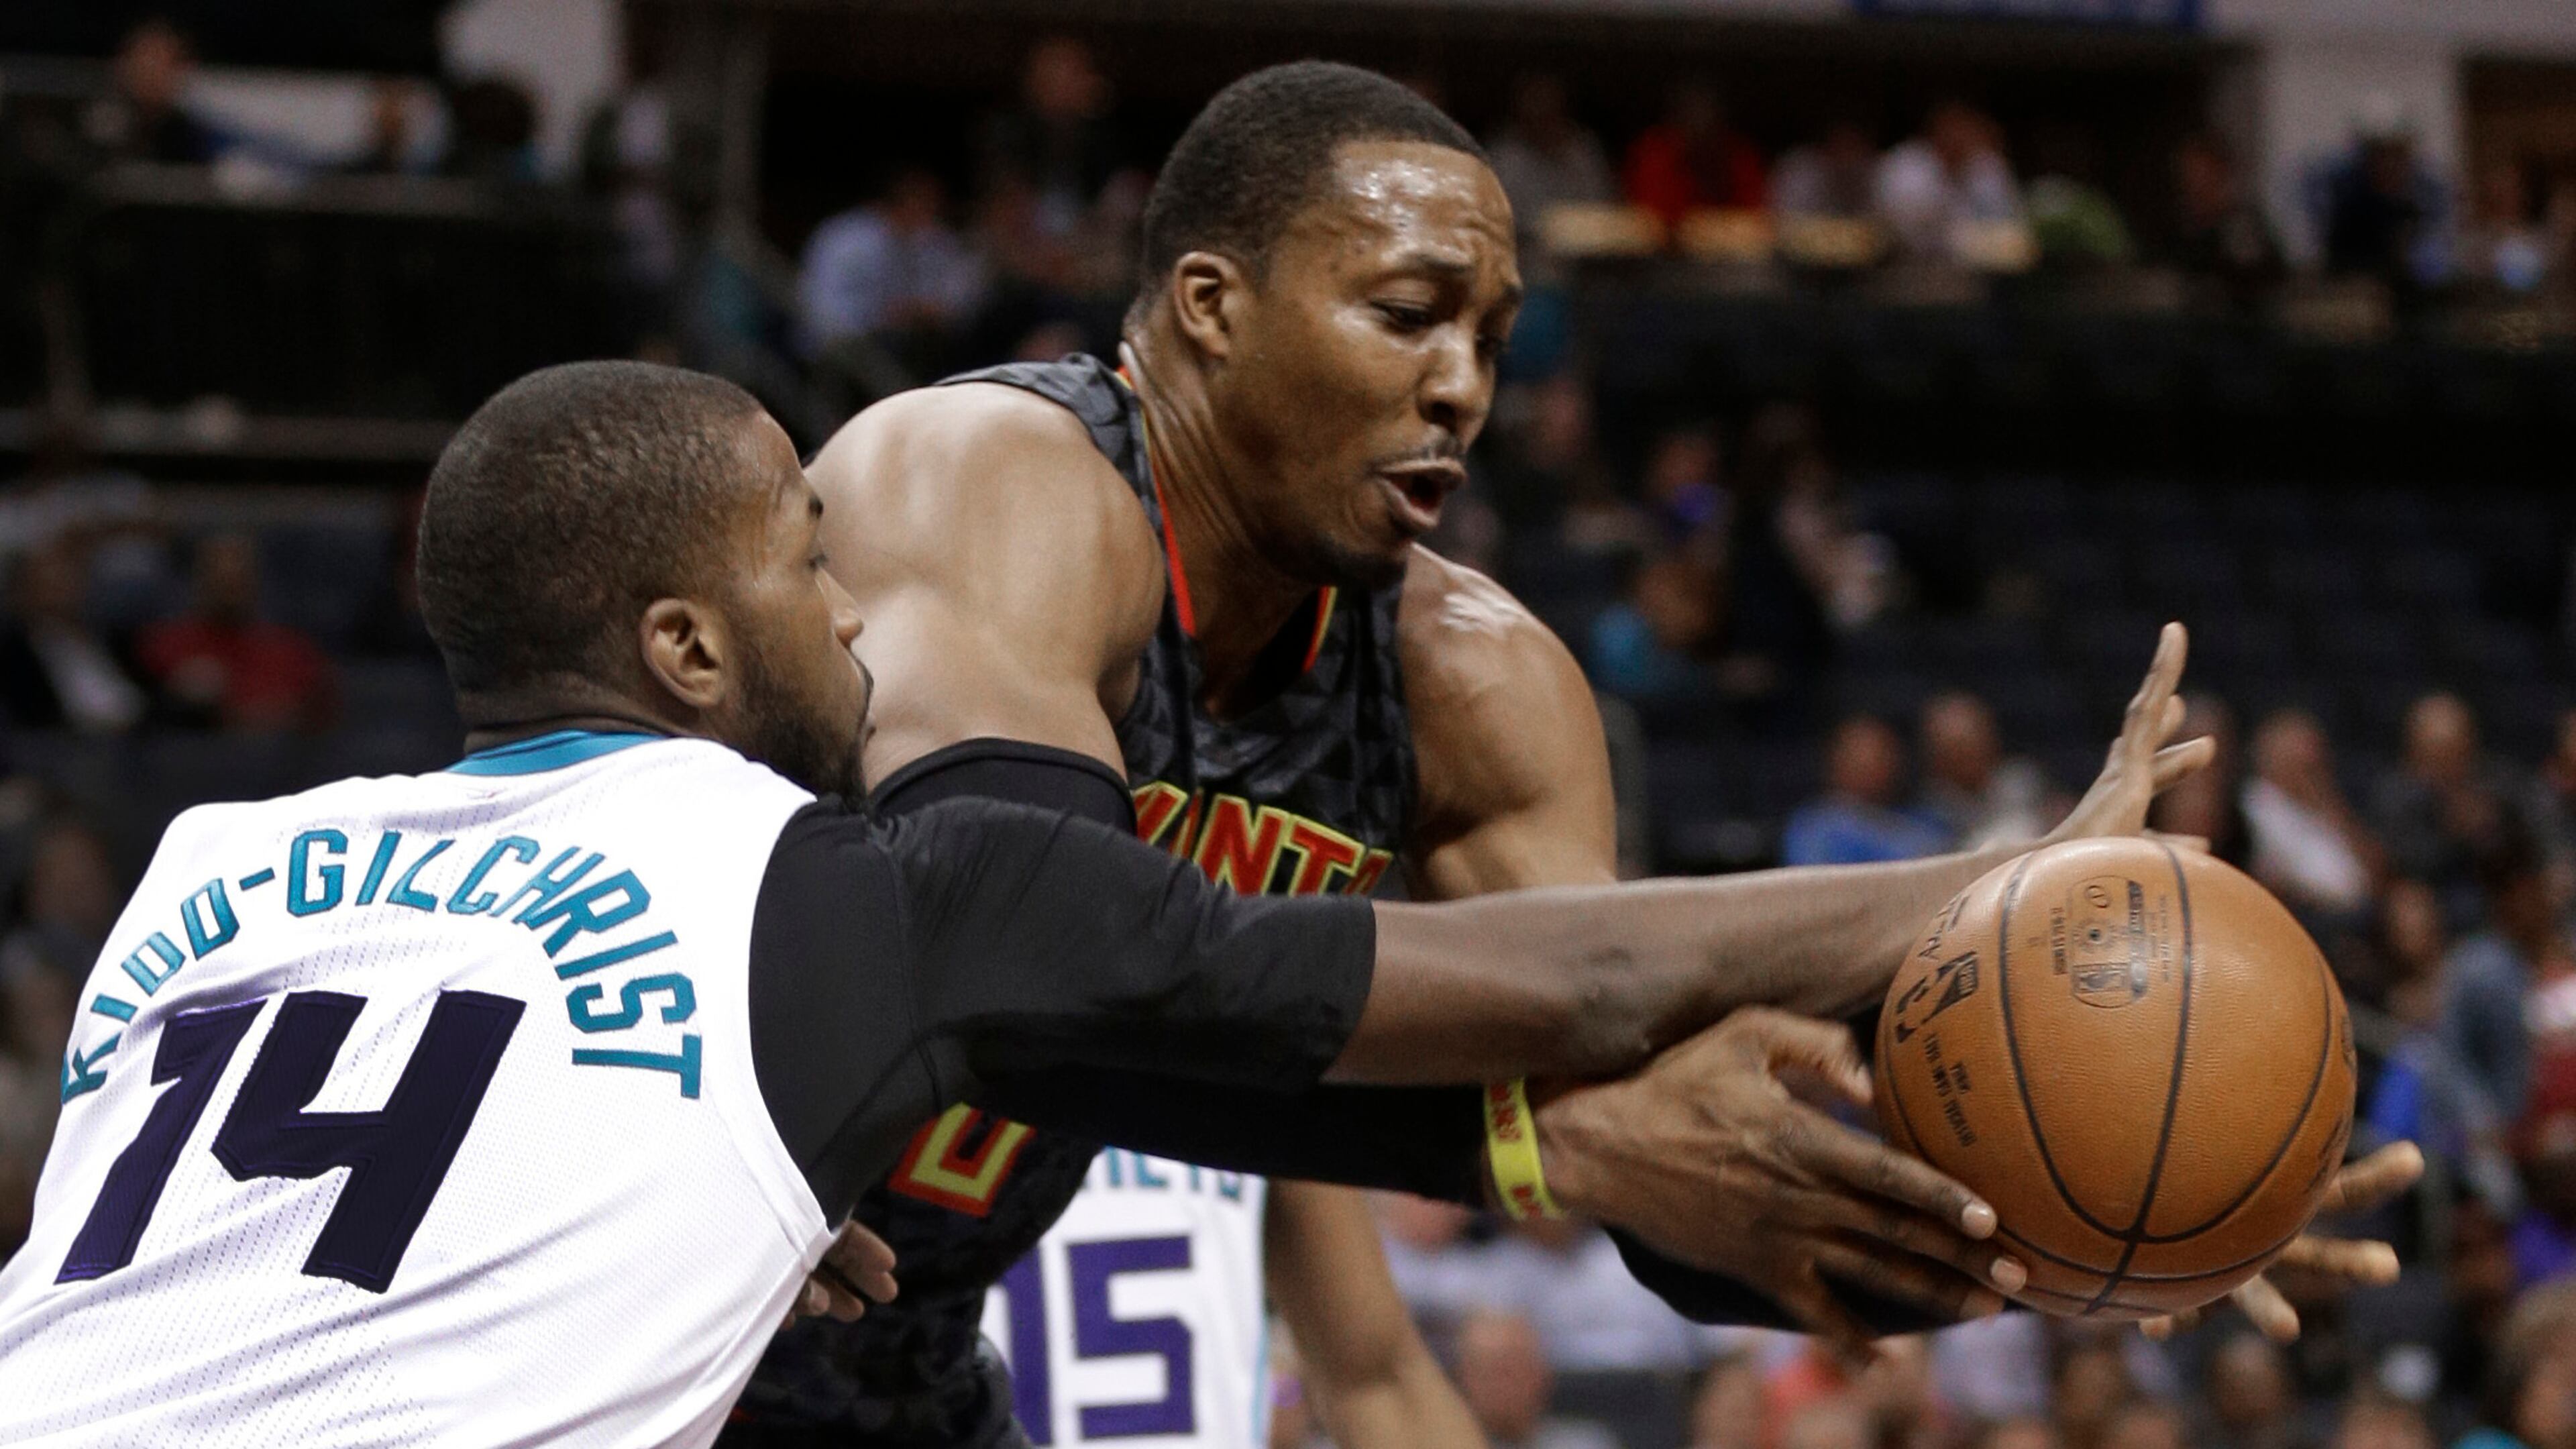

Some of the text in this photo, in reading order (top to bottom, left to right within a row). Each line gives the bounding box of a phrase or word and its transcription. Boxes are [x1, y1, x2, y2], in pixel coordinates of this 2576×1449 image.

[60, 829, 702, 1101] KIDD-GILCHRIST
[55, 990, 527, 1292] 14
[996, 1236, 1195, 1446] 15
